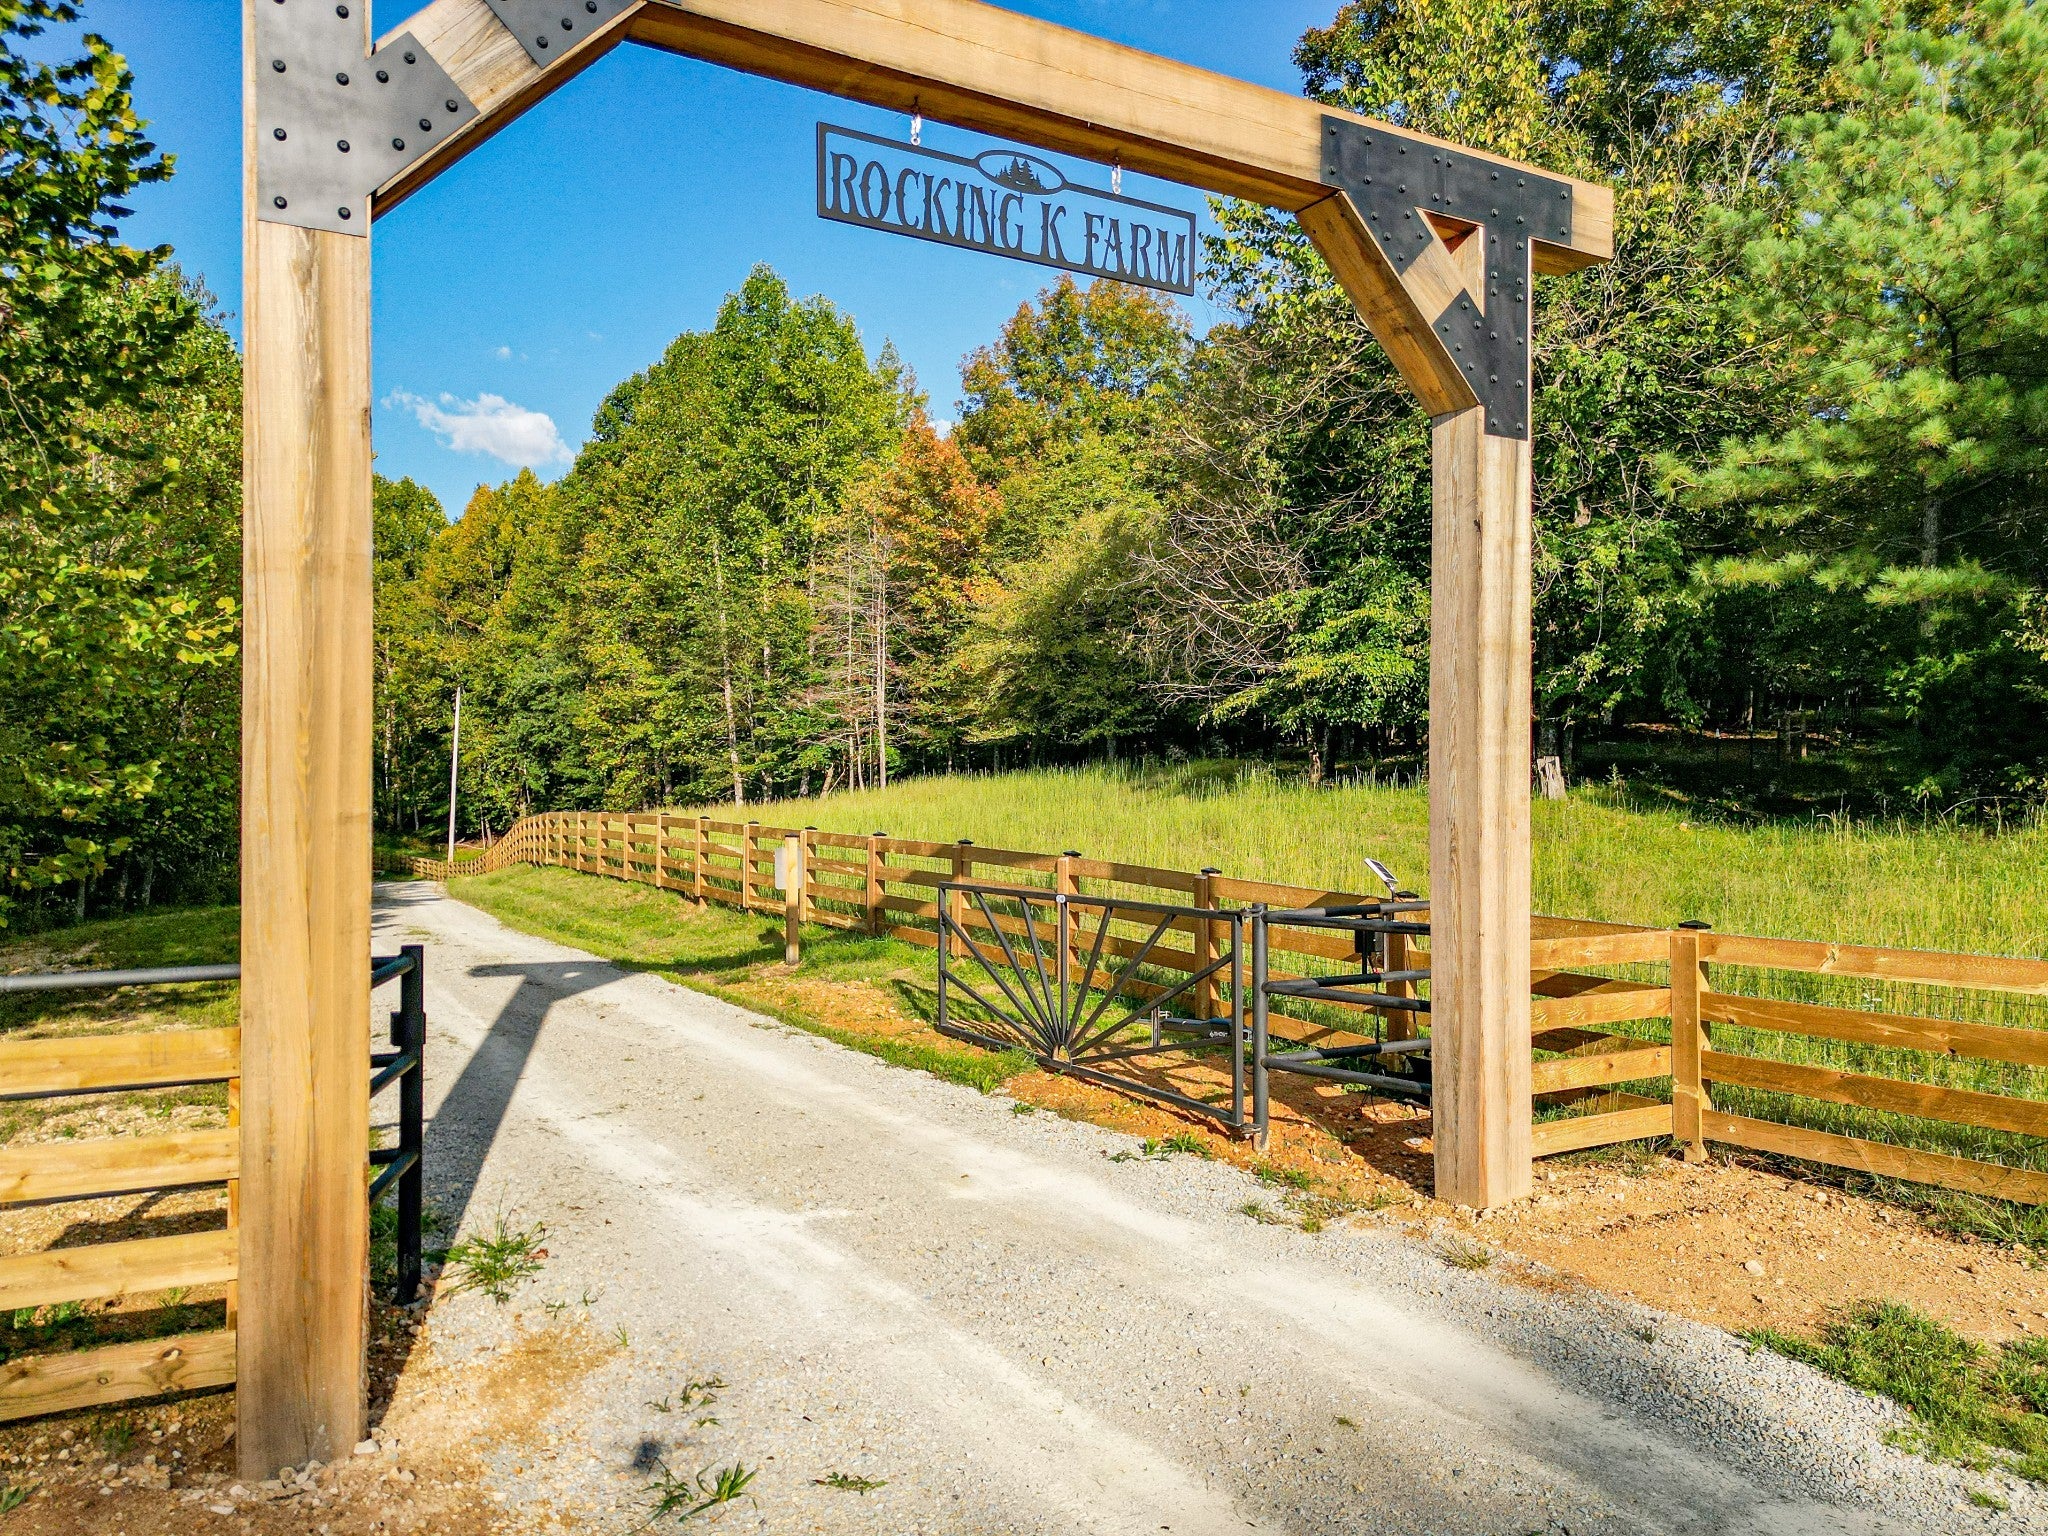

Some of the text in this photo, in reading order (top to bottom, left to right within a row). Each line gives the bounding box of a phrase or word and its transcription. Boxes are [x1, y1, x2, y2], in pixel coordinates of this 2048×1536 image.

[830, 151, 1187, 287] ROCKING K FARM
